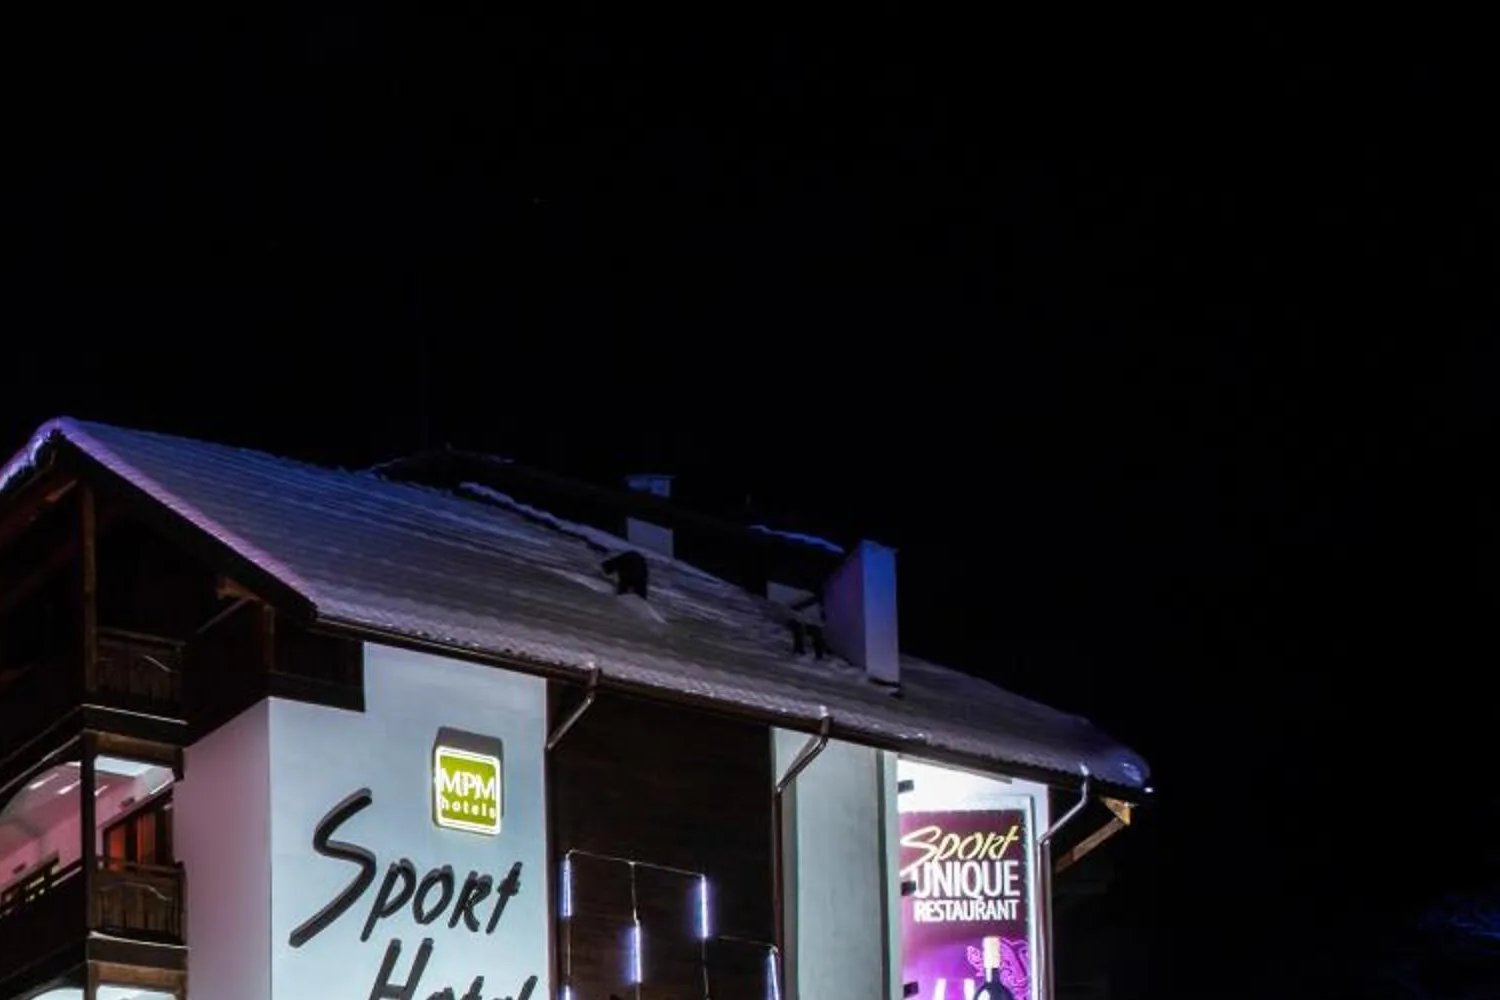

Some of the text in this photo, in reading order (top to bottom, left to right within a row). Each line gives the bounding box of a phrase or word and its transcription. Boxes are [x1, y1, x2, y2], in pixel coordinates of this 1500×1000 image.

[438, 767, 495, 800] MPM
[440, 795, 496, 819] hotels
[289, 787, 522, 948] Sport
[900, 825, 1019, 876] Sport
[911, 860, 1020, 901] UNIQUE
[913, 899, 1019, 922] RESTAURANT
